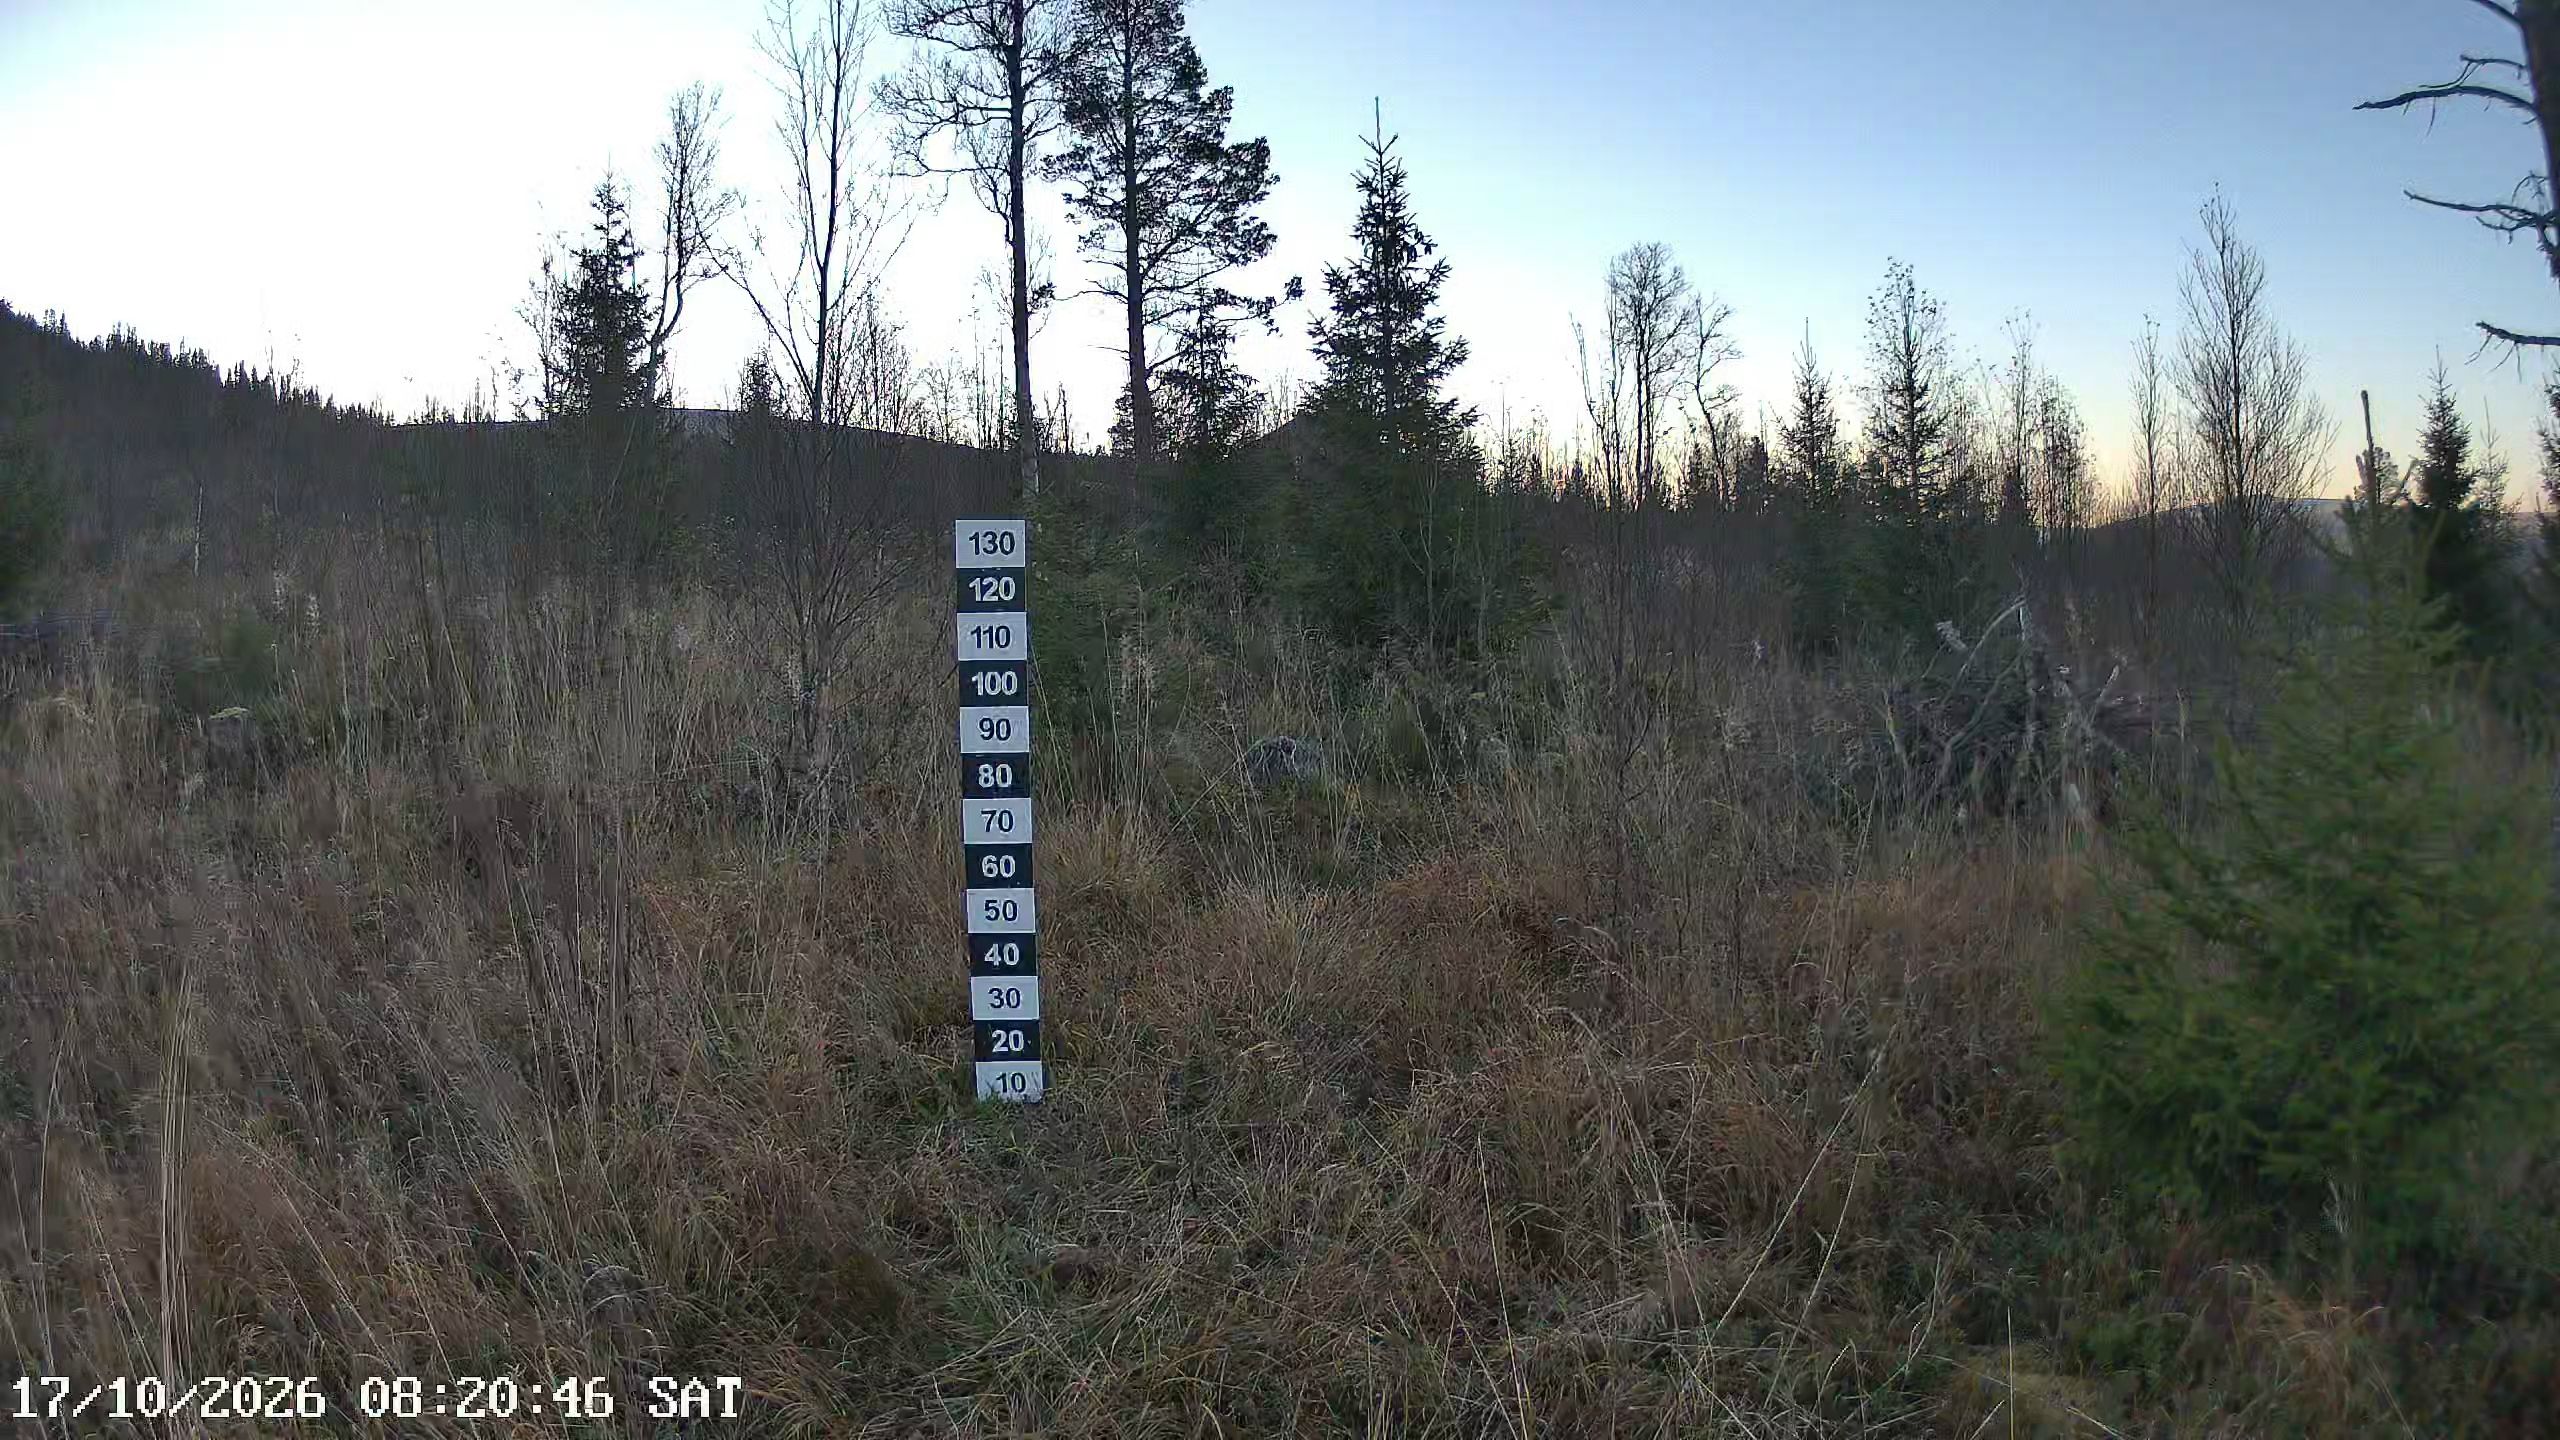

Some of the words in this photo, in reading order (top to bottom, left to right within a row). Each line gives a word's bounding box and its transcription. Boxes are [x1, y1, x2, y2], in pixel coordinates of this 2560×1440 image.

[969, 531, 1016, 555] 130
[969, 576, 1016, 601] 120
[970, 625, 1011, 649] 110
[971, 671, 1018, 696] 100
[978, 718, 1011, 741] 90
[978, 764, 1012, 788] 80
[981, 810, 1014, 833] 70
[981, 855, 1016, 878] 60
[984, 899, 1018, 922] 50
[984, 943, 1019, 966] 40
[988, 988, 1021, 1010] 30
[991, 1030, 1024, 1053] 20
[996, 1072, 1026, 1094] 10
